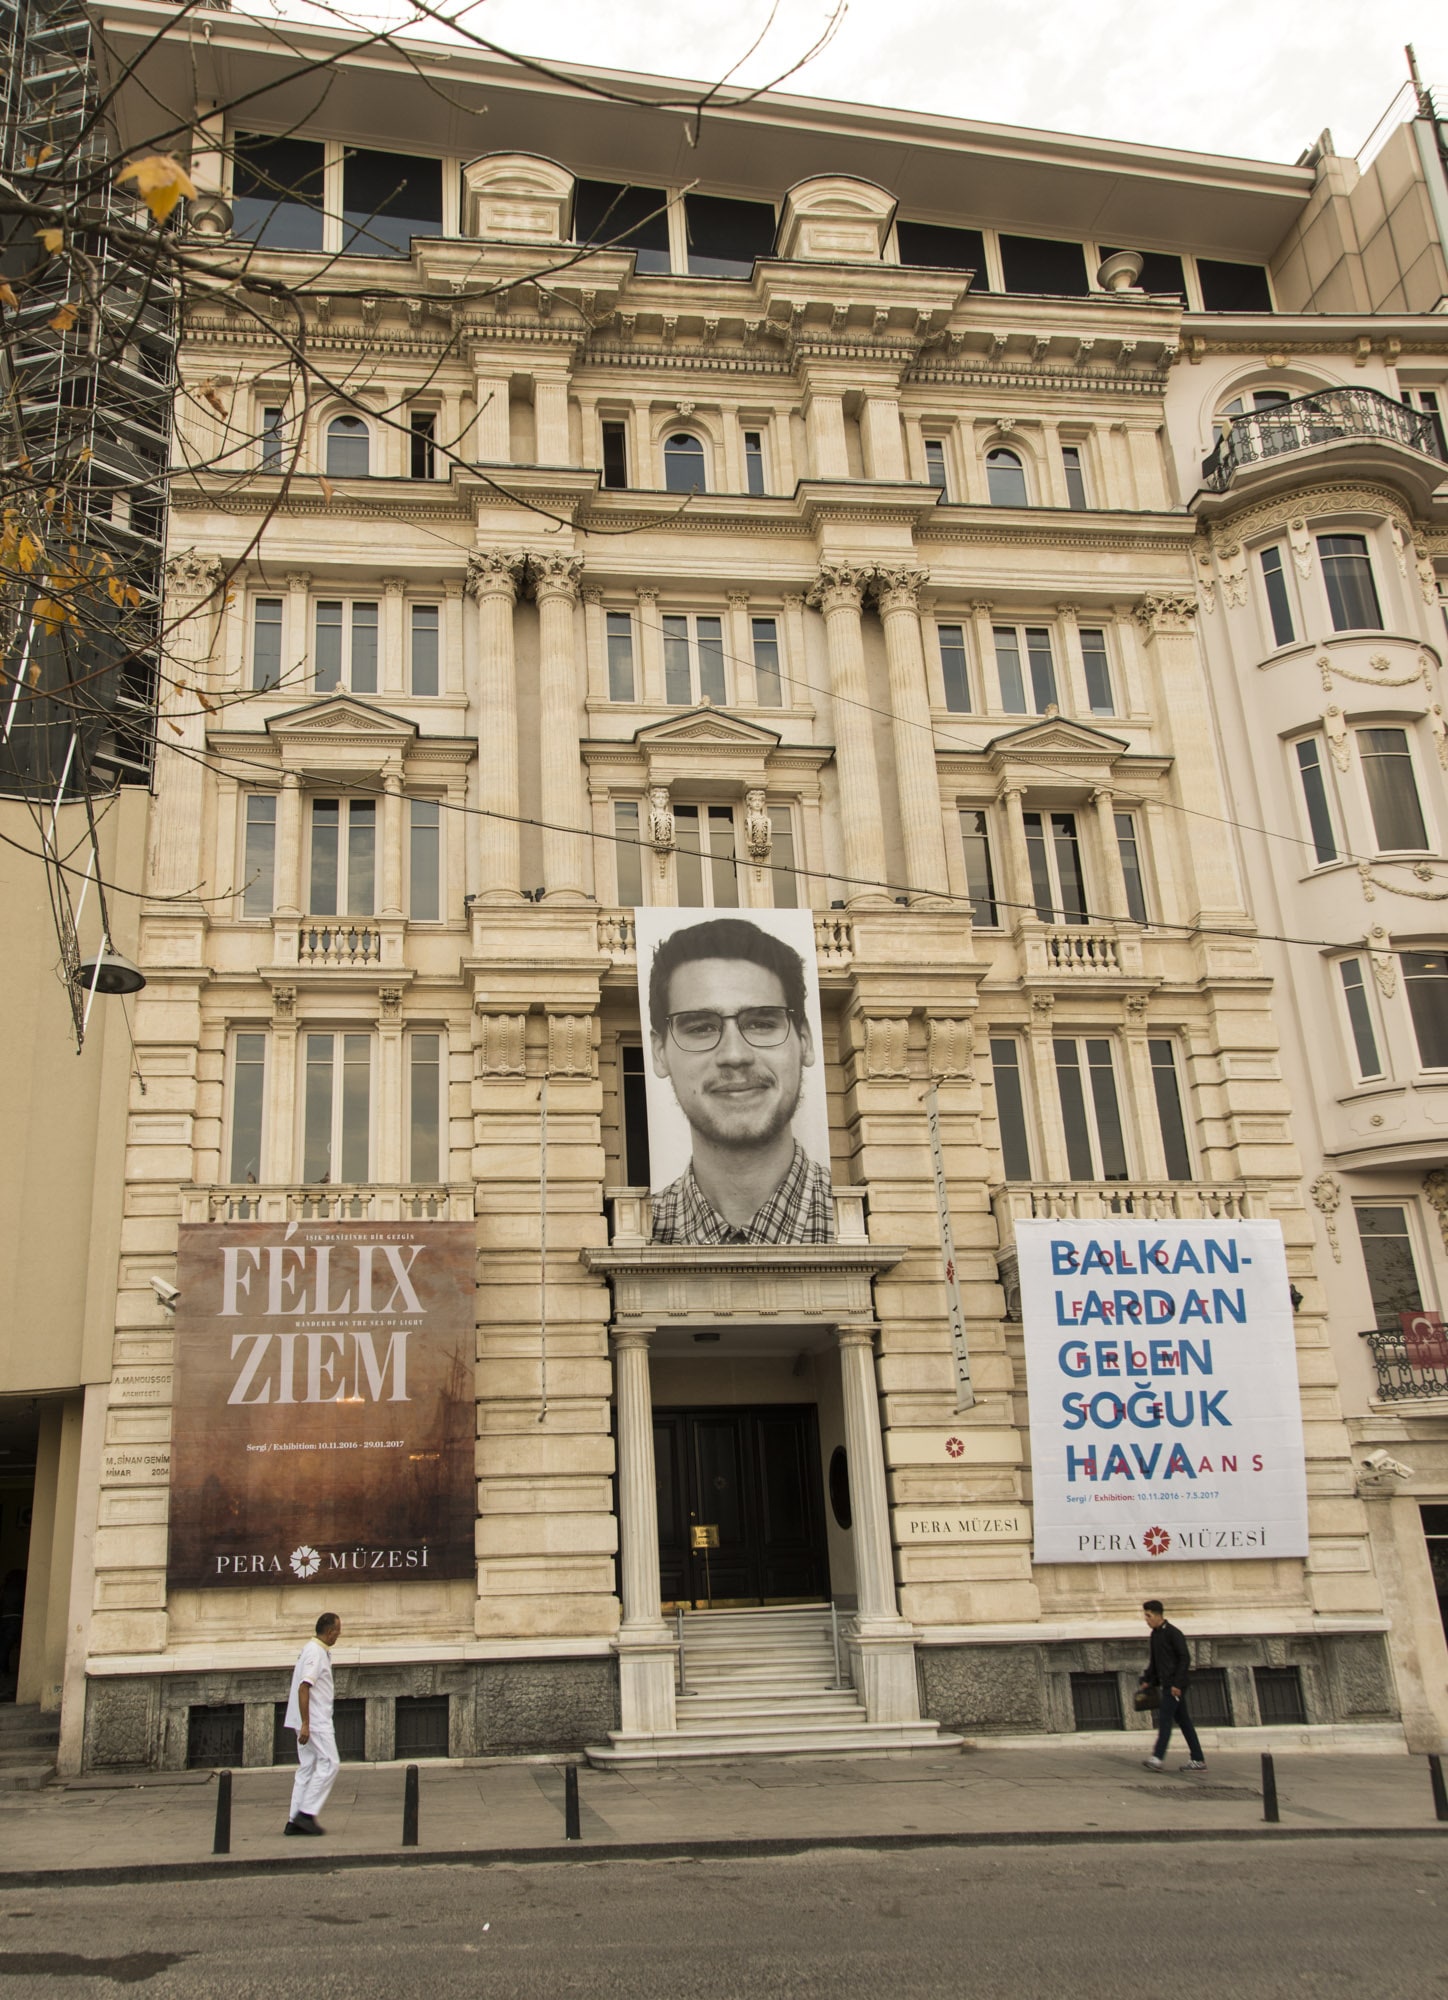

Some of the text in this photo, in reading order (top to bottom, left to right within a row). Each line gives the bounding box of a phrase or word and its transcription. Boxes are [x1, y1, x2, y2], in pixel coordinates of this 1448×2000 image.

[216, 1221, 428, 1316] FÉLIX
[1050, 1239, 1251, 1275] BALKAN-
[1067, 1250, 1169, 1267] COLD
[1055, 1288, 1247, 1326] LARDAN
[1072, 1299, 1209, 1318] FRONT
[227, 1332, 413, 1404] ZIEM
[1058, 1339, 1213, 1378] GELEN
[1076, 1351, 1180, 1369] FROM
[1062, 1382, 1233, 1430] SOĞUK
[1079, 1402, 1165, 1421] THE
[246, 1443, 267, 1452] Sergi
[273, 1443, 317, 1451] Exhibition:
[318, 1442, 358, 1450] 10.11.2016
[363, 1440, 405, 1449] 29.01.2017
[105, 1466, 169, 1477] MİMAR 2004
[1066, 1443, 1198, 1482] HAVA
[1084, 1455, 1264, 1476] BALKANS
[1066, 1494, 1087, 1504] Sergi
[1094, 1493, 1135, 1502] Exhibition:
[1137, 1492, 1179, 1501] 10.11.2016
[1186, 1491, 1219, 1499] 7.5.2017
[911, 1517, 1018, 1533] PERA MÜZESİ
[1078, 1526, 1267, 1551] PERA MÜZESİ
[215, 1545, 429, 1574] PERA MÜZESİ
